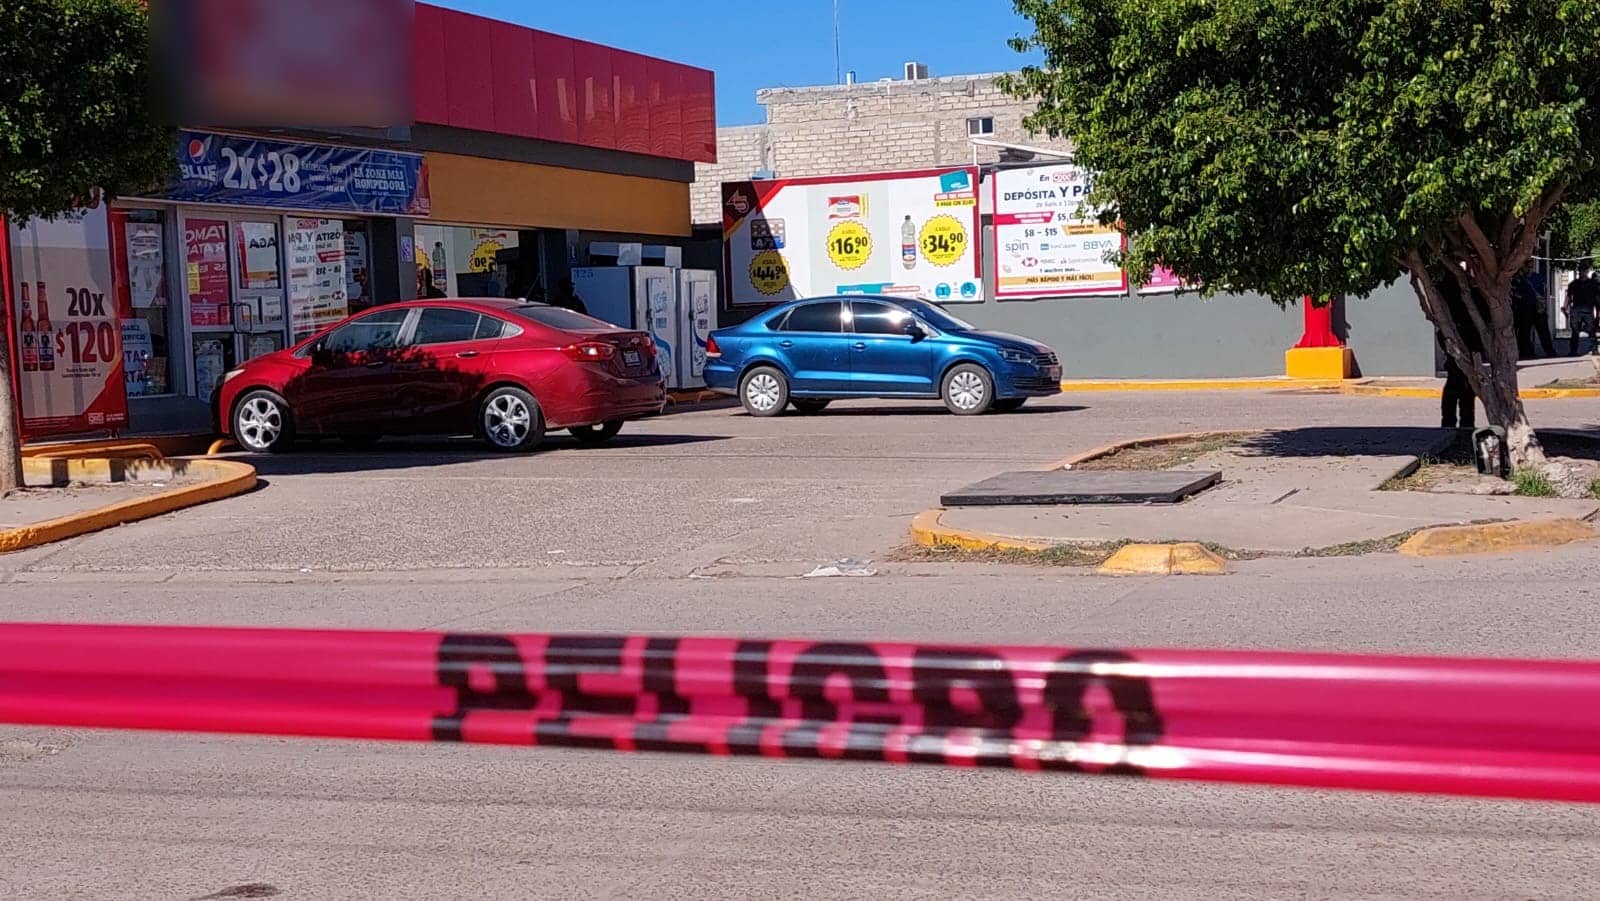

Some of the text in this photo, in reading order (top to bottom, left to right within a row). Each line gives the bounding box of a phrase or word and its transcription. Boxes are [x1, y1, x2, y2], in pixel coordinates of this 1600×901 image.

[365, 168, 387, 179] ZONA
[354, 178, 406, 191] ROMPEDORA
[1003, 187, 1057, 201] DEPÓSITA
[1059, 186, 1069, 198] Y
[1045, 227, 1058, 237] $15
[1005, 240, 1029, 253] spin
[1083, 240, 1113, 250] BBVA
[55, 321, 115, 364] $120
[432, 632, 1163, 777] PELIGRO
